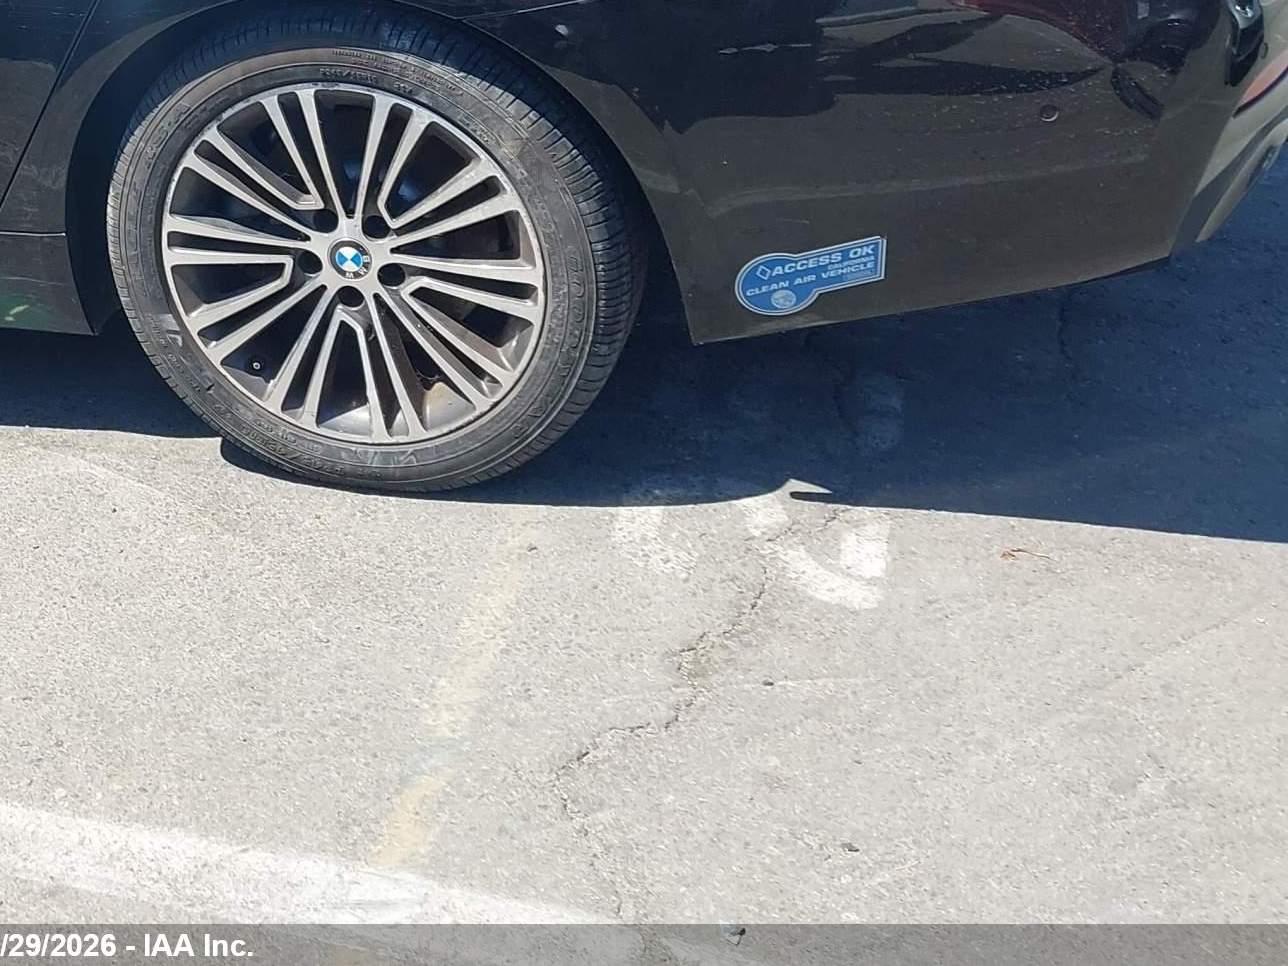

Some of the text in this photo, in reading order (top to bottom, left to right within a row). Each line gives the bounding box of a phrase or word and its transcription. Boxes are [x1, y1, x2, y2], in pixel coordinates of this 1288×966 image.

[772, 252, 842, 276] ACCESS
[849, 244, 876, 258] OK
[746, 280, 789, 296] CLEAN
[793, 274, 817, 285] AIR
[821, 261, 875, 278] VEHICLE
